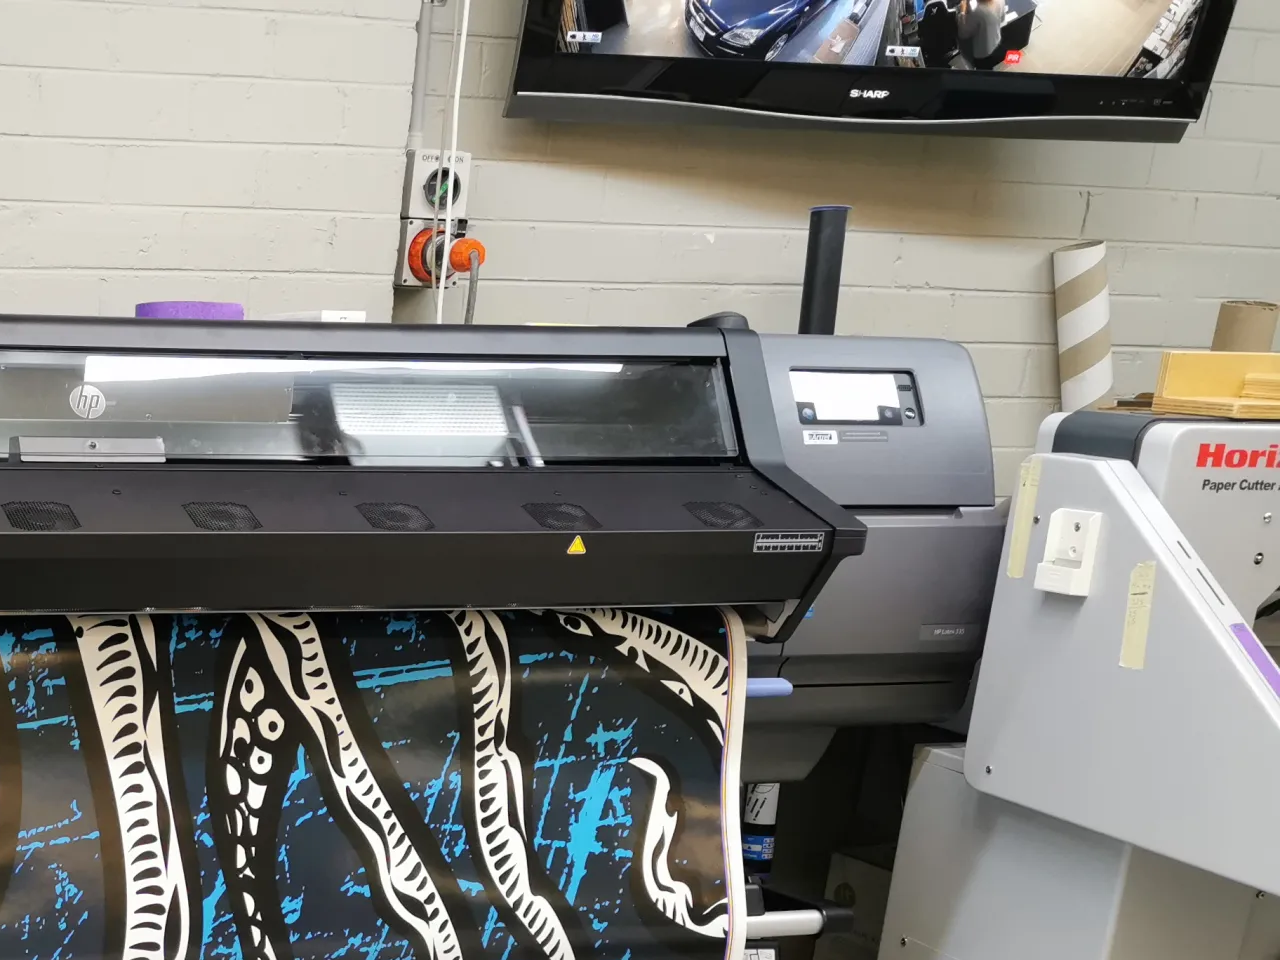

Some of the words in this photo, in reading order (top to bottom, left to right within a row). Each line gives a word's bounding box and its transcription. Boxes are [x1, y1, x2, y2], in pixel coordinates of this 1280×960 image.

[850, 89, 890, 98] SHARP
[75, 384, 102, 419] hp
[1196, 443, 1280, 468] Hori
[1201, 479, 1237, 493] Paper
[1239, 479, 1276, 491] Cutter
